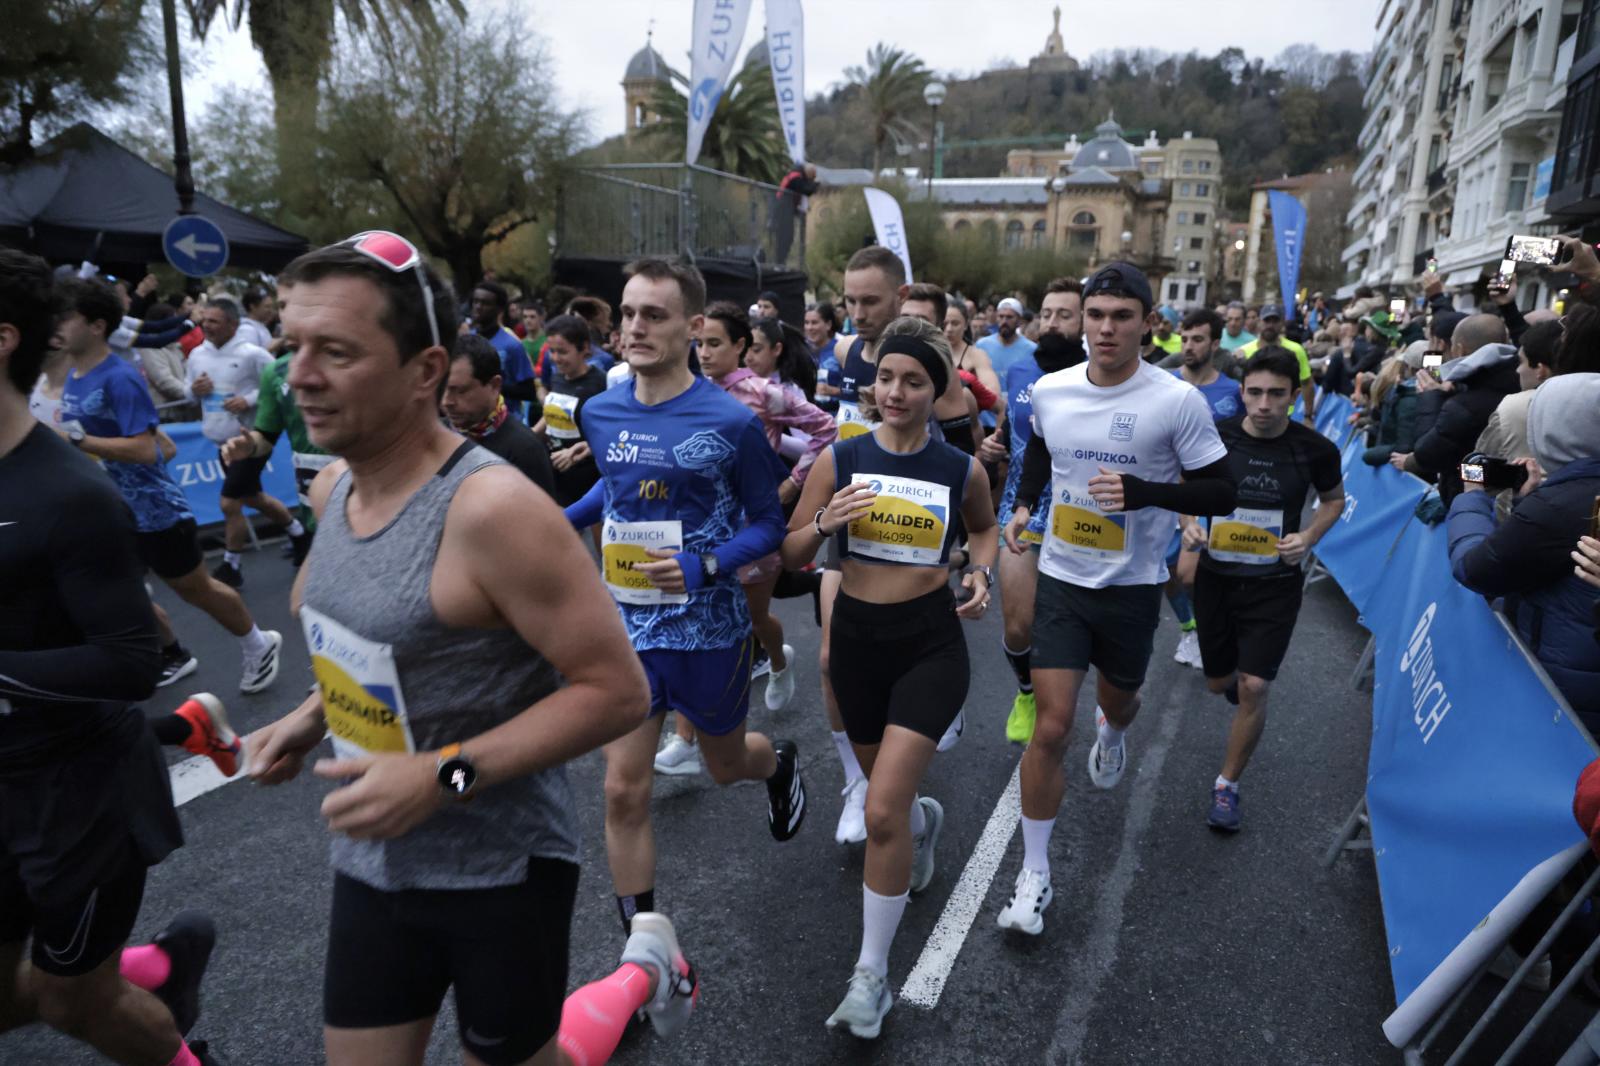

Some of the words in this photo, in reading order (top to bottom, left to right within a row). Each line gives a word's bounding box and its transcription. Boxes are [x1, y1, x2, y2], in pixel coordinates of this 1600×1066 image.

[630, 433, 658, 442] ZURICH
[888, 484, 933, 498] ZURICH
[870, 511, 935, 530] MAIDER
[1074, 521, 1102, 535] JON
[620, 530, 664, 541] ZURICH
[879, 530, 913, 543] 14099
[1072, 535, 1097, 547] 11996
[1230, 533, 1268, 543] OIHAN
[1411, 636, 1451, 744] ZURICH
